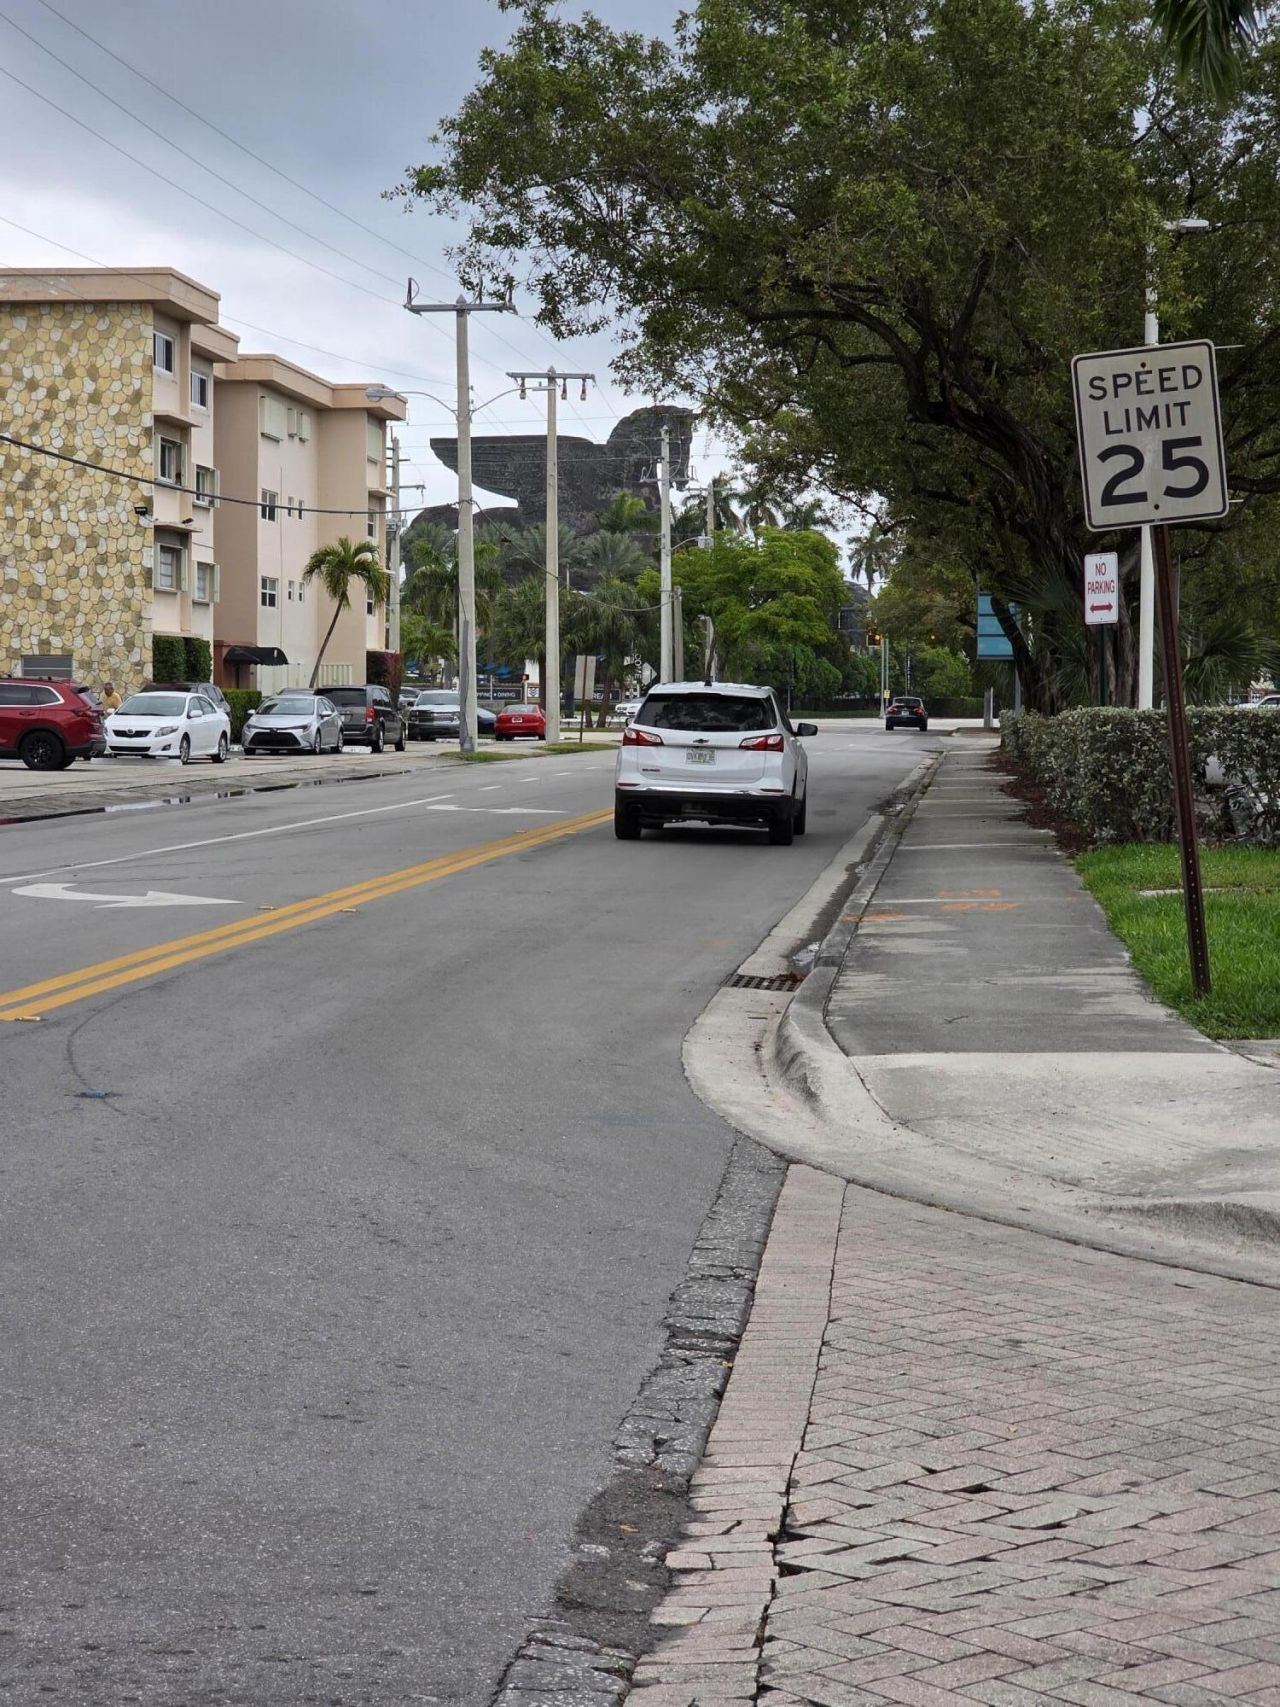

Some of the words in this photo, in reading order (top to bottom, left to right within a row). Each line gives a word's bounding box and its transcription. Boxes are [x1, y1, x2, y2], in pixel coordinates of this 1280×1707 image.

[1088, 365, 1203, 401] SPEED
[1104, 401, 1191, 435] LIMIT
[1097, 436, 1209, 507] 25
[1095, 562, 1107, 576] NO
[1088, 579, 1115, 594] PARKING
